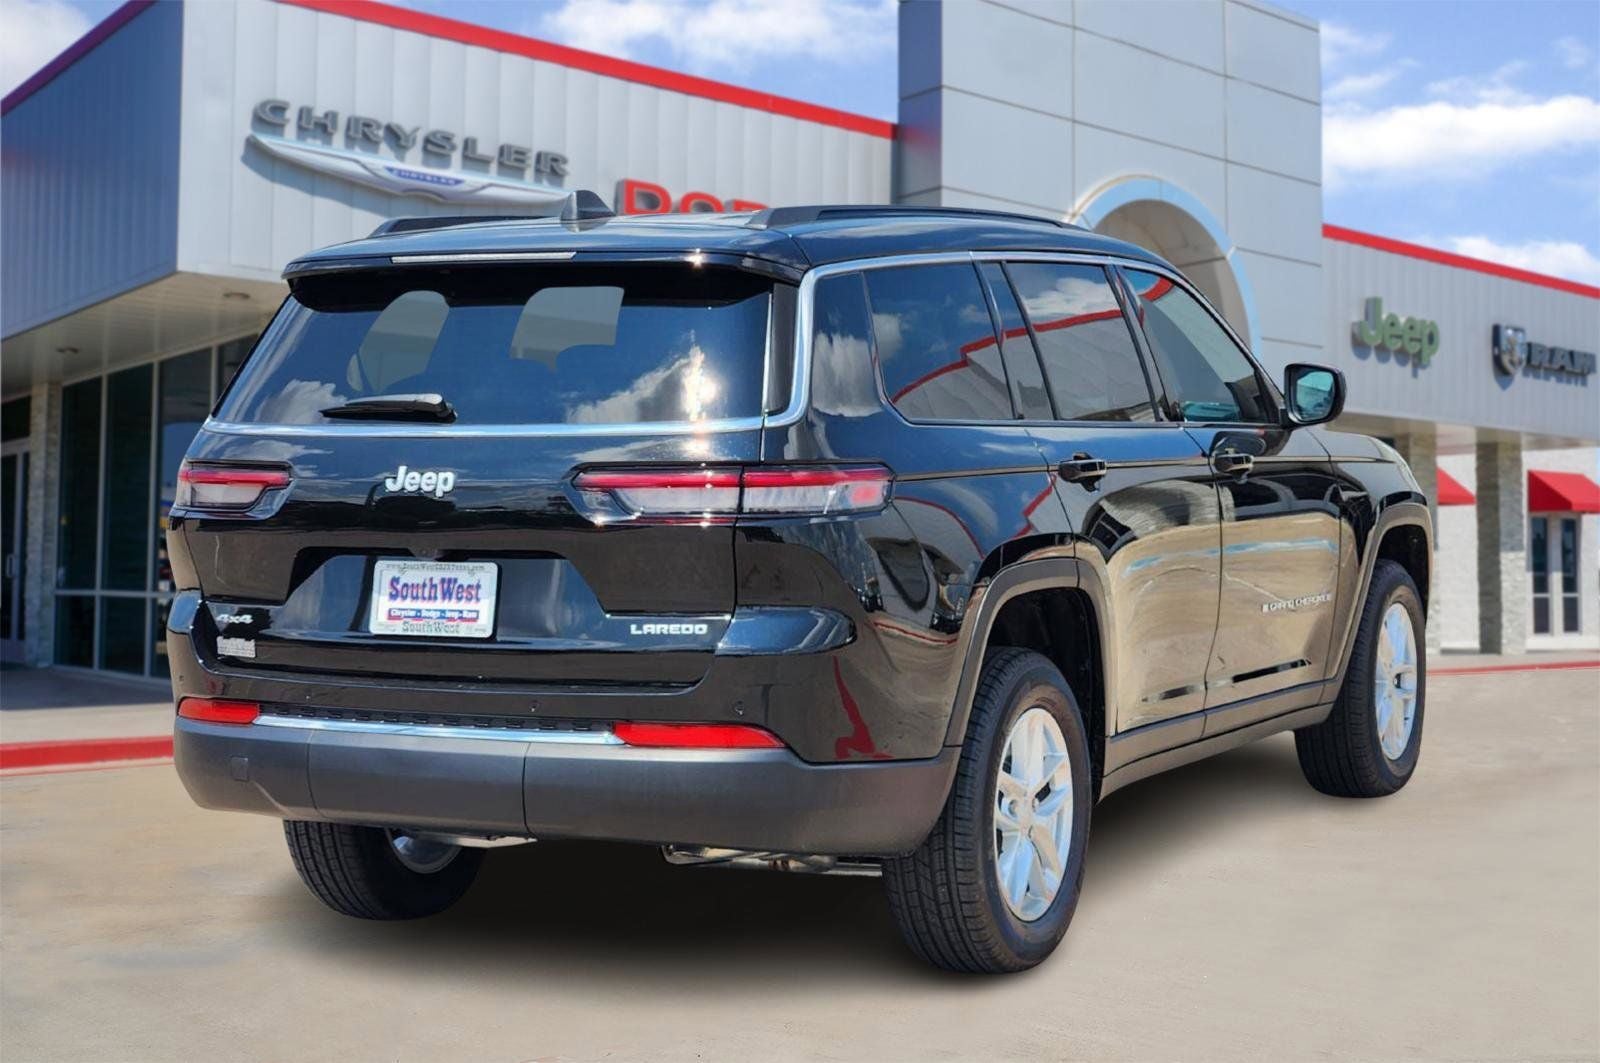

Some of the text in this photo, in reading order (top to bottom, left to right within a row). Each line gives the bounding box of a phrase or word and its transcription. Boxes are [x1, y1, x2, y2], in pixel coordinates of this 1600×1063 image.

[251, 99, 569, 176] CHRYSLER
[1354, 296, 1440, 365] Jeep
[1526, 343, 1596, 376] RAM
[385, 465, 455, 497] Jeep
[389, 576, 481, 602] SouthWest
[216, 614, 253, 624] 4x4
[630, 624, 708, 635] LAREDO
